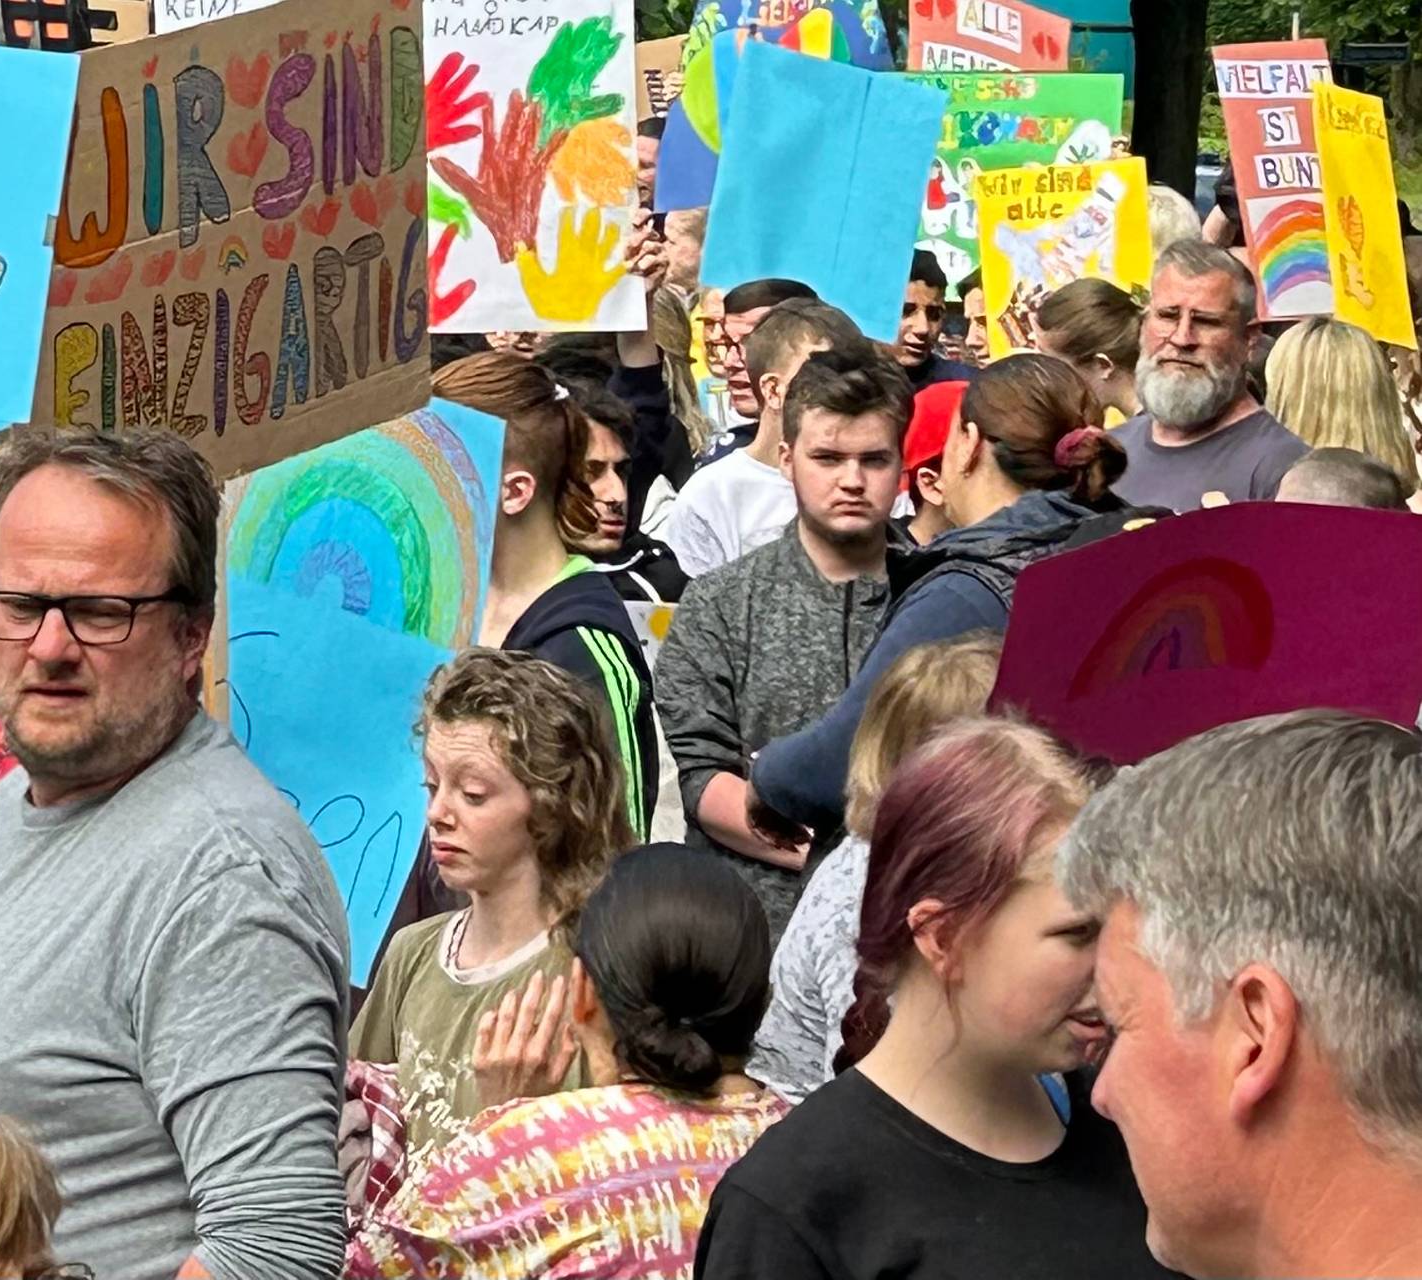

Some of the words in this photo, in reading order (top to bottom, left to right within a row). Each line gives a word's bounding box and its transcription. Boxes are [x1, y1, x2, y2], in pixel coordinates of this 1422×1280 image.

[54, 63, 232, 269] WIR
[253, 25, 421, 220] SIND
[1217, 63, 1329, 94] VIELFALT
[53, 215, 427, 439] EINZIGARTIG
